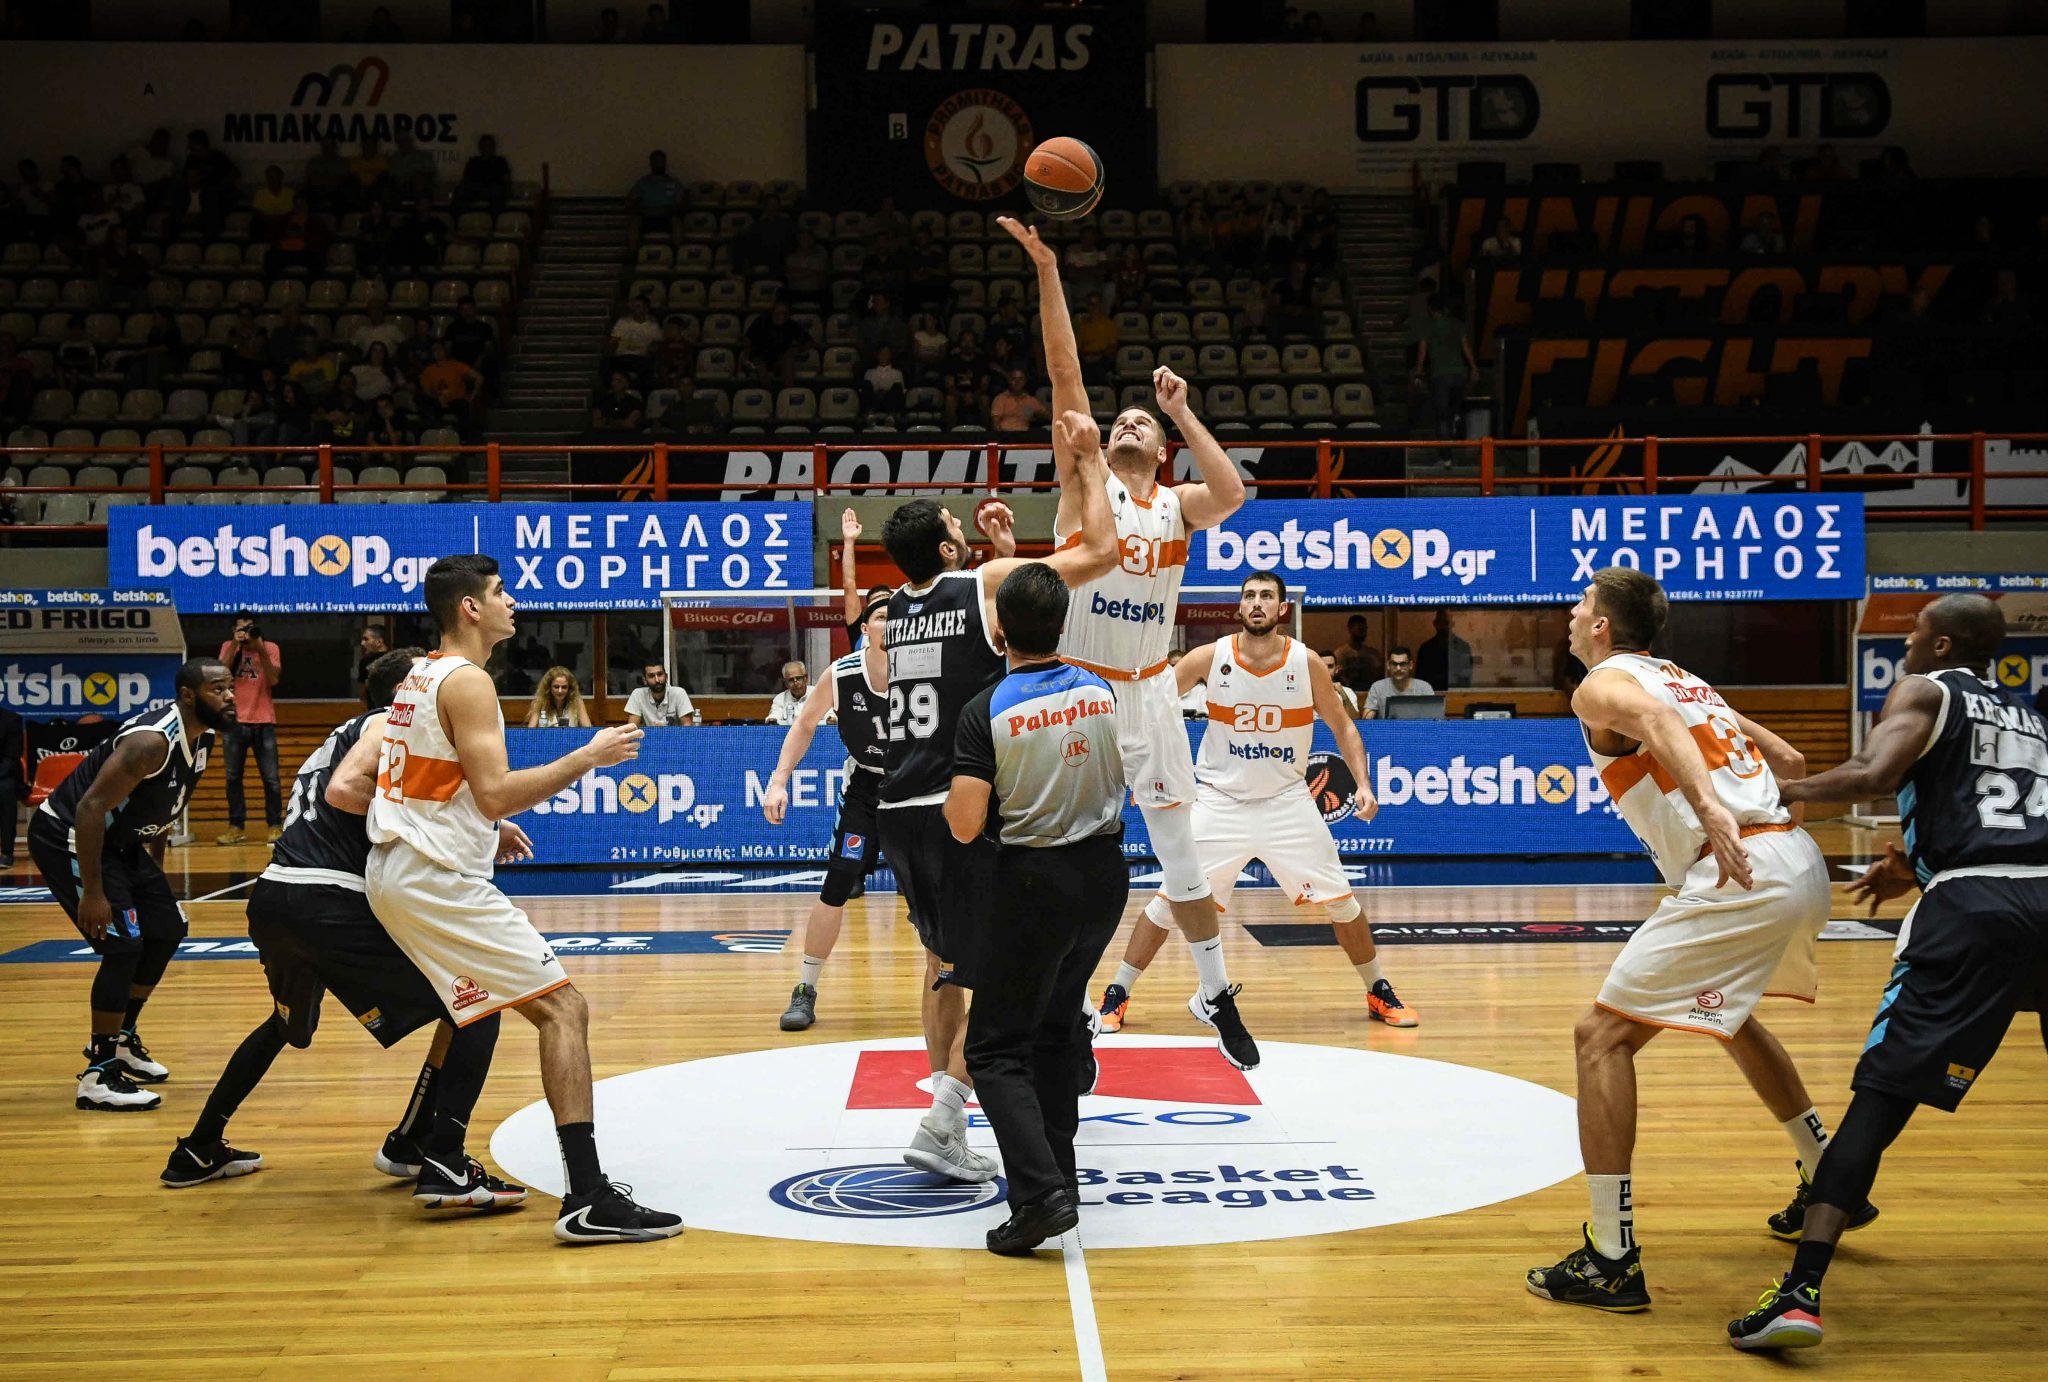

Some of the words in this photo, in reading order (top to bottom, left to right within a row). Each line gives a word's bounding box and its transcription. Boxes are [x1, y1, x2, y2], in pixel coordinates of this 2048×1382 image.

[865, 22, 1094, 71] PATRAS
[928, 90, 1031, 136] PROMITHEAS
[1356, 74, 1540, 141] GTD
[1706, 72, 1891, 139] GTD
[934, 163, 1003, 199] PATRAS
[720, 447, 1266, 502] PROMITAS
[515, 512, 789, 549] ΜΕΓΑΛΟΣ
[1571, 505, 1841, 541] ΜΕΓΑΛΟΣ
[1120, 533, 1162, 577] 31
[1206, 517, 1495, 586] betshop.gr
[1571, 545, 1841, 582] ΧΟΡΗΓΟΣ
[514, 553, 789, 590] ΧΟΡΗΓΟΣ
[684, 612, 729, 624] Βίκος
[732, 611, 774, 624] Cola
[807, 611, 846, 622] Βίκο
[1187, 608, 1231, 619] Βίκος
[1358, 595, 1380, 604] MGA
[42, 608, 151, 630] FRIGO
[886, 609, 967, 646] ΥΤΖΙΑΡΑΚΗΣ
[78, 637, 116, 646] always
[135, 635, 159, 644] time
[889, 682, 940, 742] 29
[1008, 698, 1114, 738] Palaplast
[1233, 703, 1282, 733] 20
[610, 846, 637, 859] 21+
[653, 845, 736, 860] Ρυθμιστής:
[741, 845, 775, 858] MGA
[1690, 1007, 1722, 1018] Airgon
[1076, 1165, 1365, 1186] Basket
